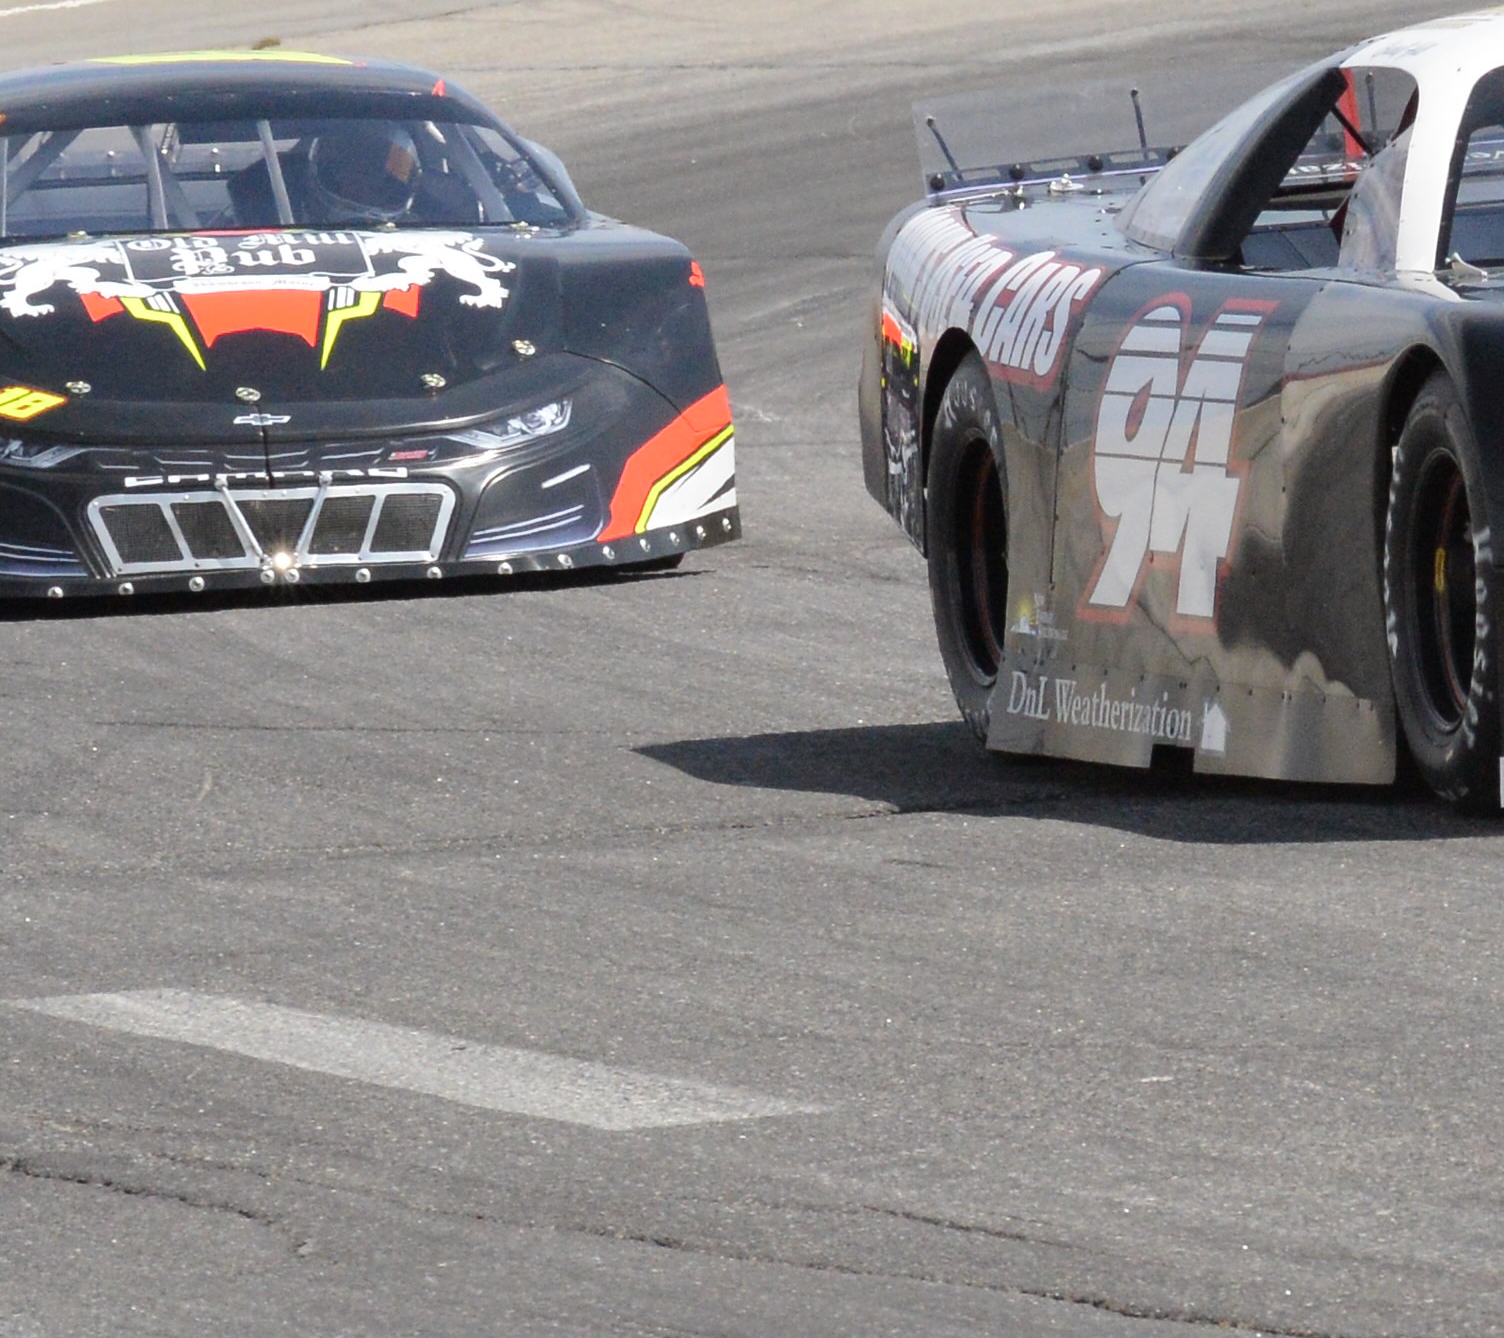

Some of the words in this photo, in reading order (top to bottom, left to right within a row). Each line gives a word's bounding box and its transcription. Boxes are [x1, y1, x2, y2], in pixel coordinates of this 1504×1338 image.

[170, 245, 316, 275] Pub
[972, 250, 1102, 376] CARS
[1088, 304, 1264, 619] 94
[1007, 671, 1051, 720] DnL
[1054, 679, 1192, 741] Weatherization
